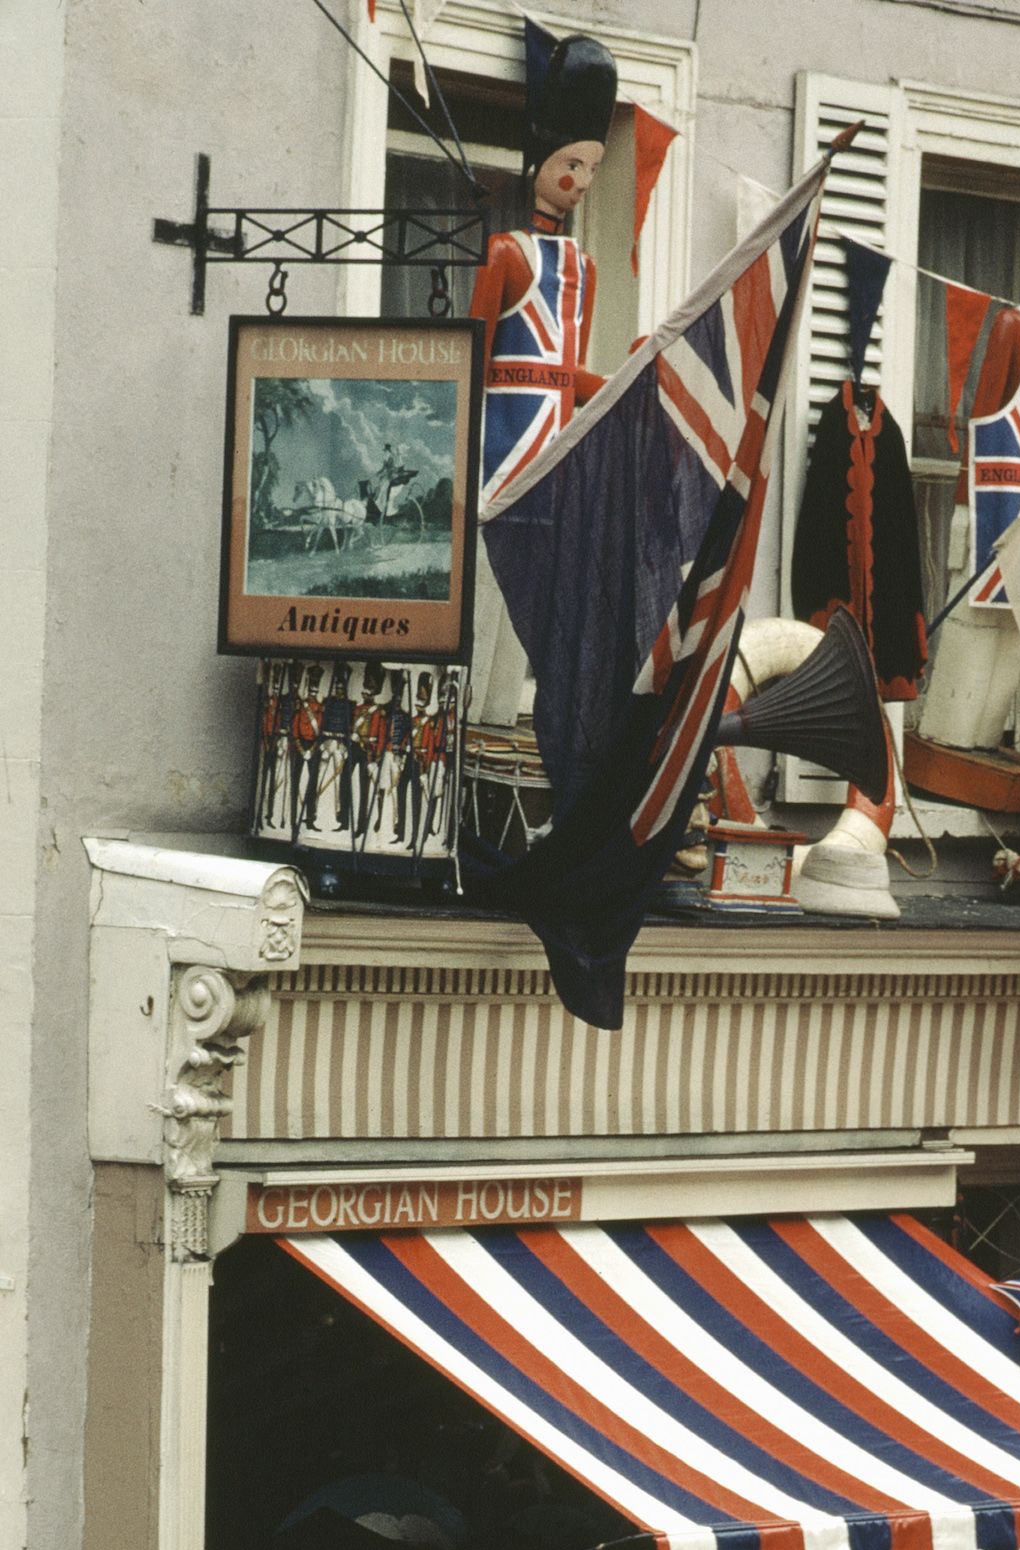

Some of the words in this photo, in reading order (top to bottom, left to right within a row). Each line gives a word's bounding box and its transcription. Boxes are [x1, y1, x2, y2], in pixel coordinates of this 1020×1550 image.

[251, 336, 370, 363] GEORGIAN
[377, 338, 464, 365] HOUSE
[491, 367, 570, 388] ENGLAND
[277, 605, 411, 642] Antiques
[257, 1184, 439, 1229] GEORGIAN
[454, 1178, 574, 1221] HOUSE
